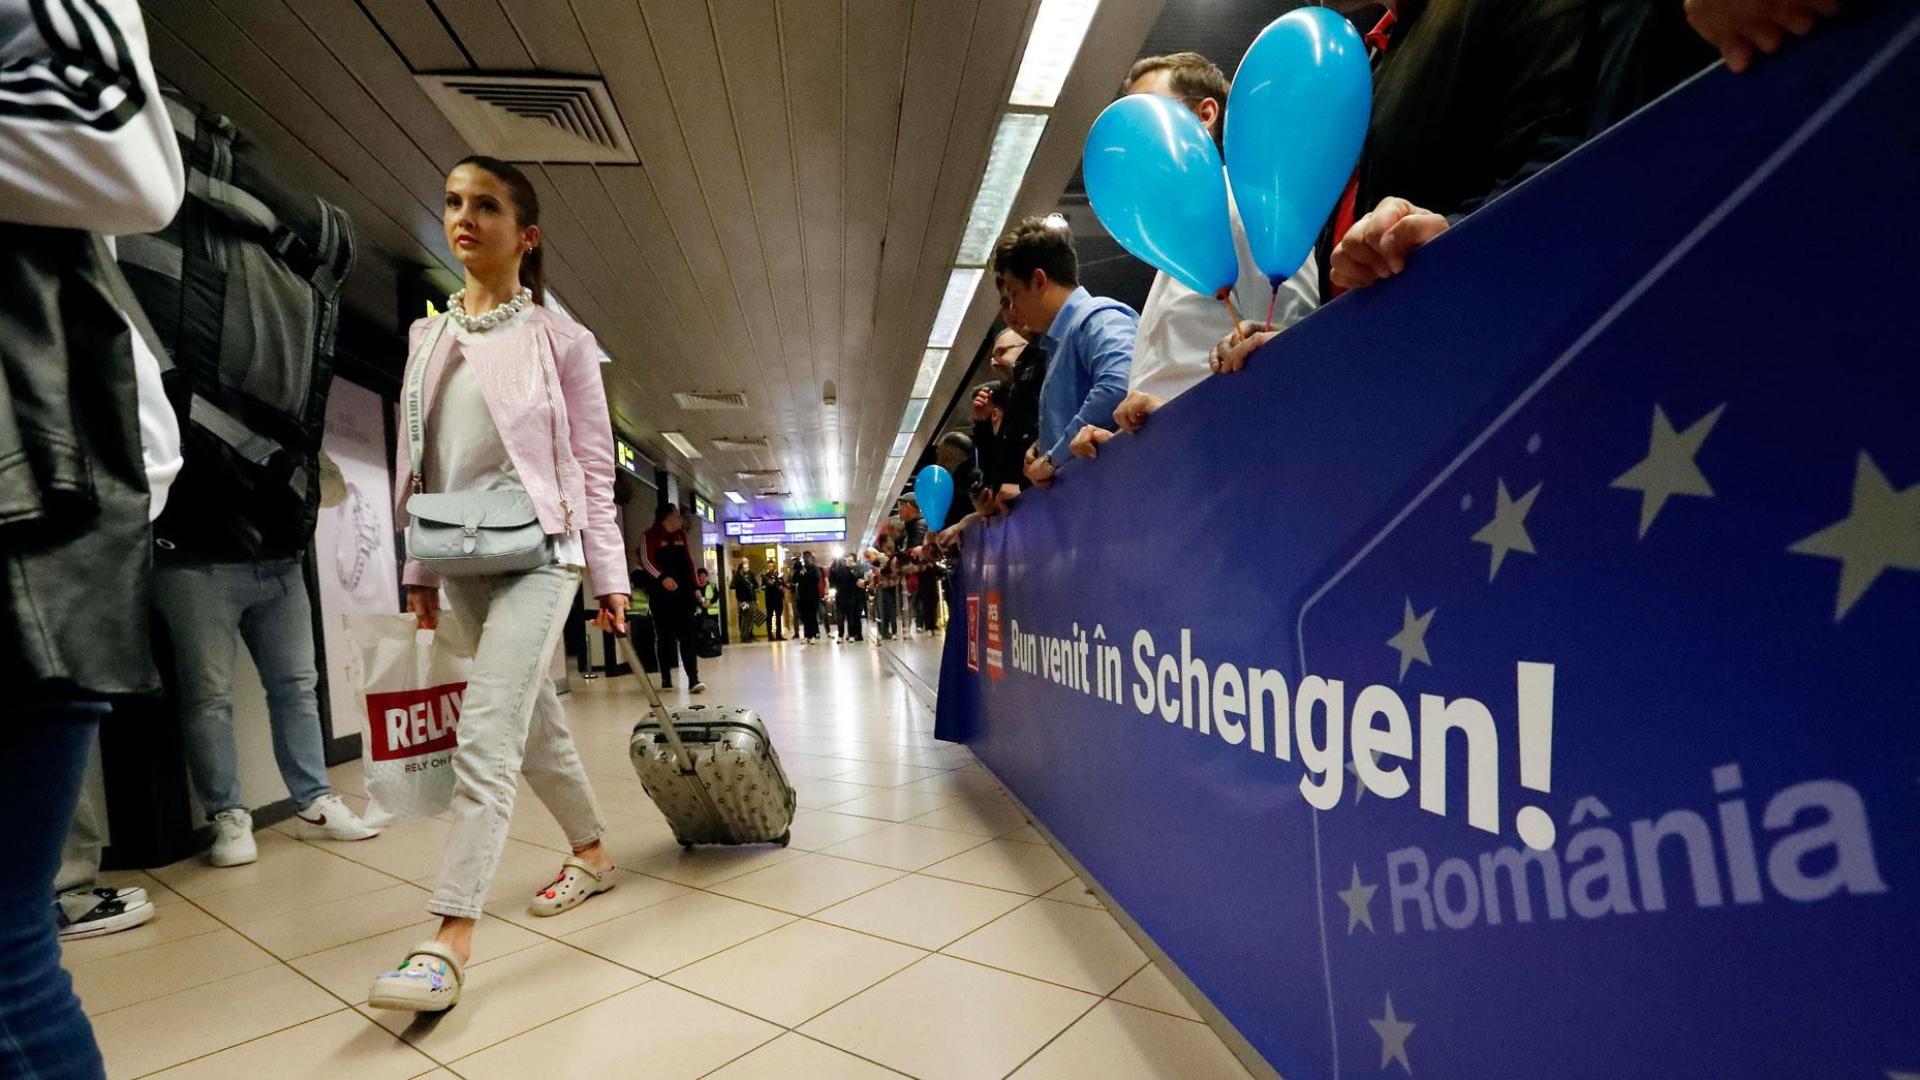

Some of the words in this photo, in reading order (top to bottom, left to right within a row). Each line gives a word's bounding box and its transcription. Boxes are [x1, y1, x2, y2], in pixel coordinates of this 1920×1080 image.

[408, 390, 421, 442] VUITTON
[404, 760, 429, 774] RELY
[1011, 618, 1037, 676] Bun
[1040, 621, 1091, 695] venit
[1093, 623, 1123, 705] în
[1132, 628, 1557, 852] Schengen!
[1386, 762, 1890, 935] România
